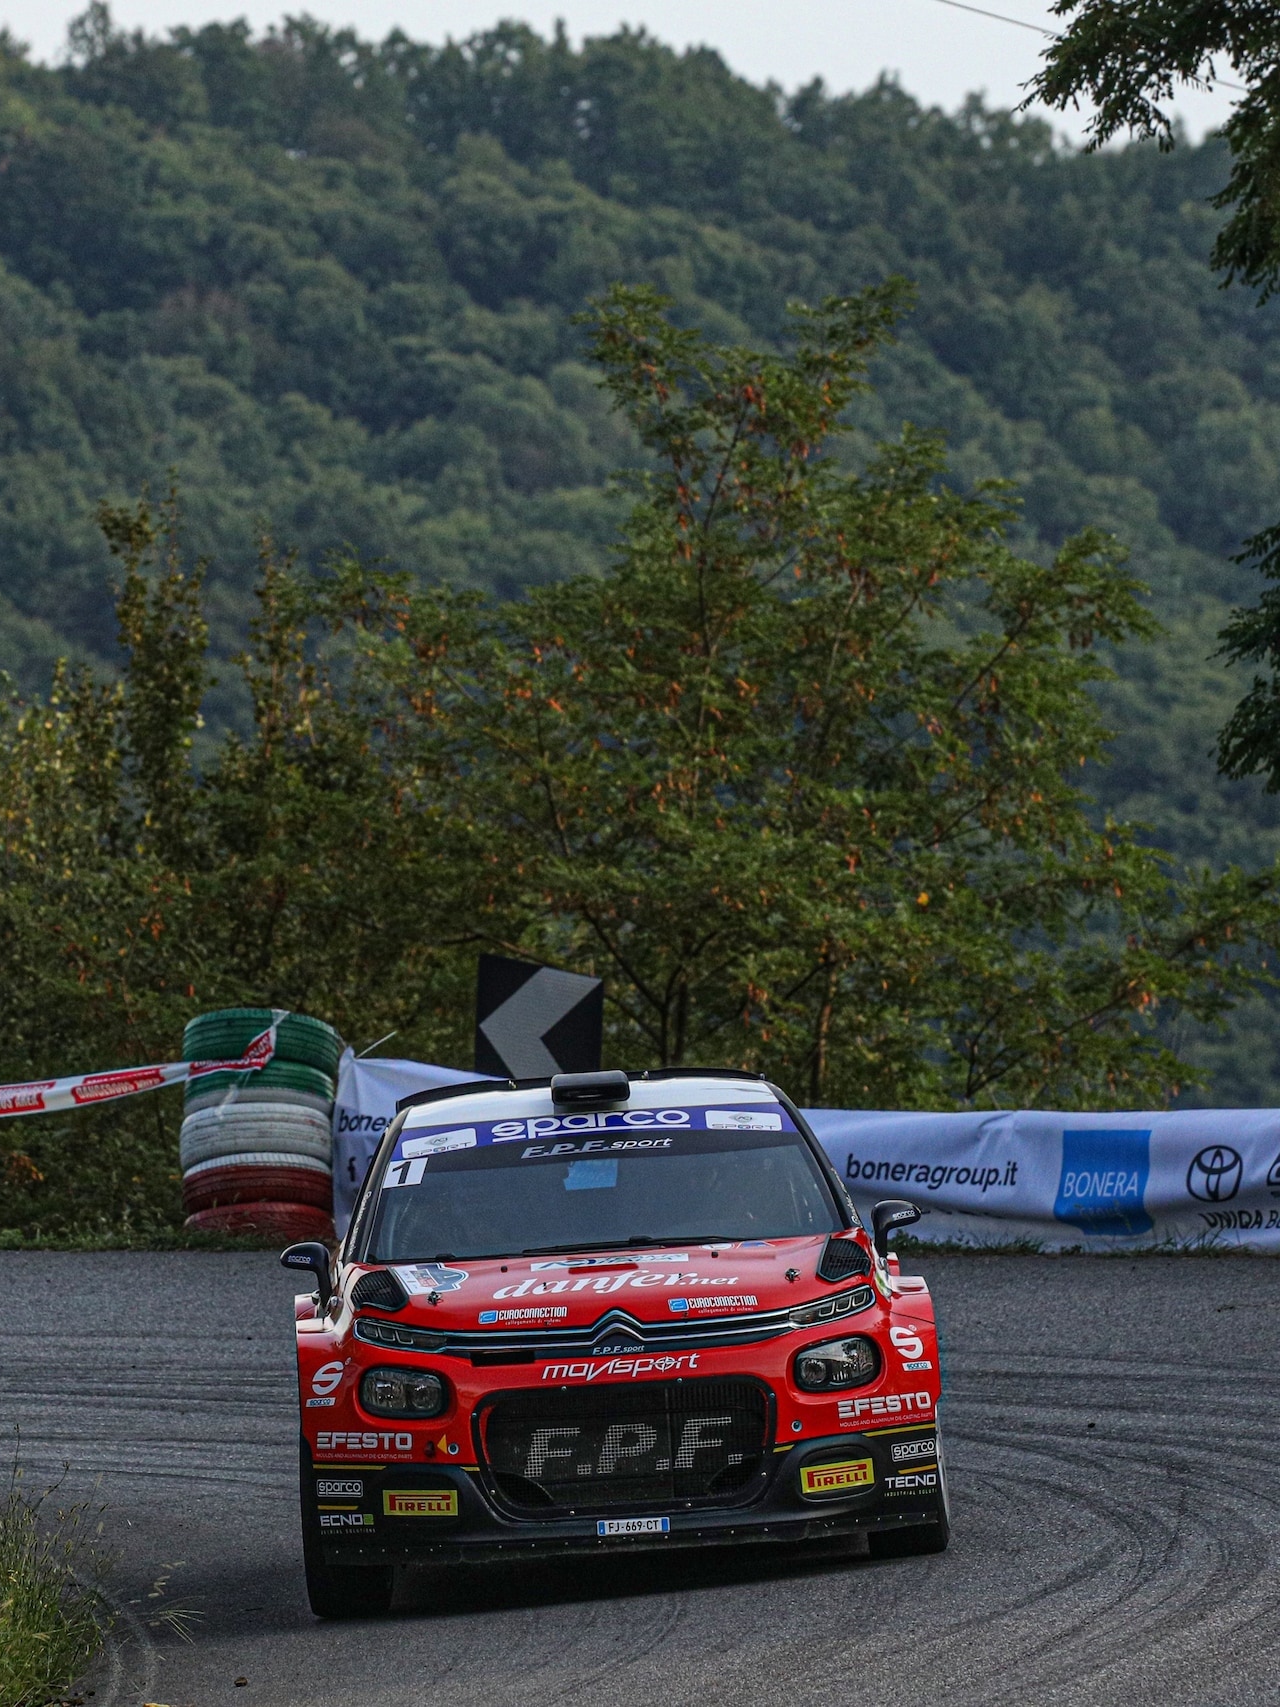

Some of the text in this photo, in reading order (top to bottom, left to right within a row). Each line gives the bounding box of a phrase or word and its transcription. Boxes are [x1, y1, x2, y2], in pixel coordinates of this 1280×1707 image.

[491, 1109, 690, 1140] sparco
[392, 1160, 412, 1185] 1
[846, 1153, 1019, 1193] boneragroup.it
[1063, 1171, 1139, 1198] BONERA
[493, 1269, 739, 1300] danfer.net
[542, 1352, 700, 1381] movisport
[837, 1391, 932, 1419] EFESTO
[317, 1432, 413, 1450] EFESTO
[893, 1439, 936, 1461] sparco
[318, 1481, 361, 1495] sparco
[807, 1463, 868, 1488] PIRELLI
[388, 1494, 451, 1512] PIRELLI
